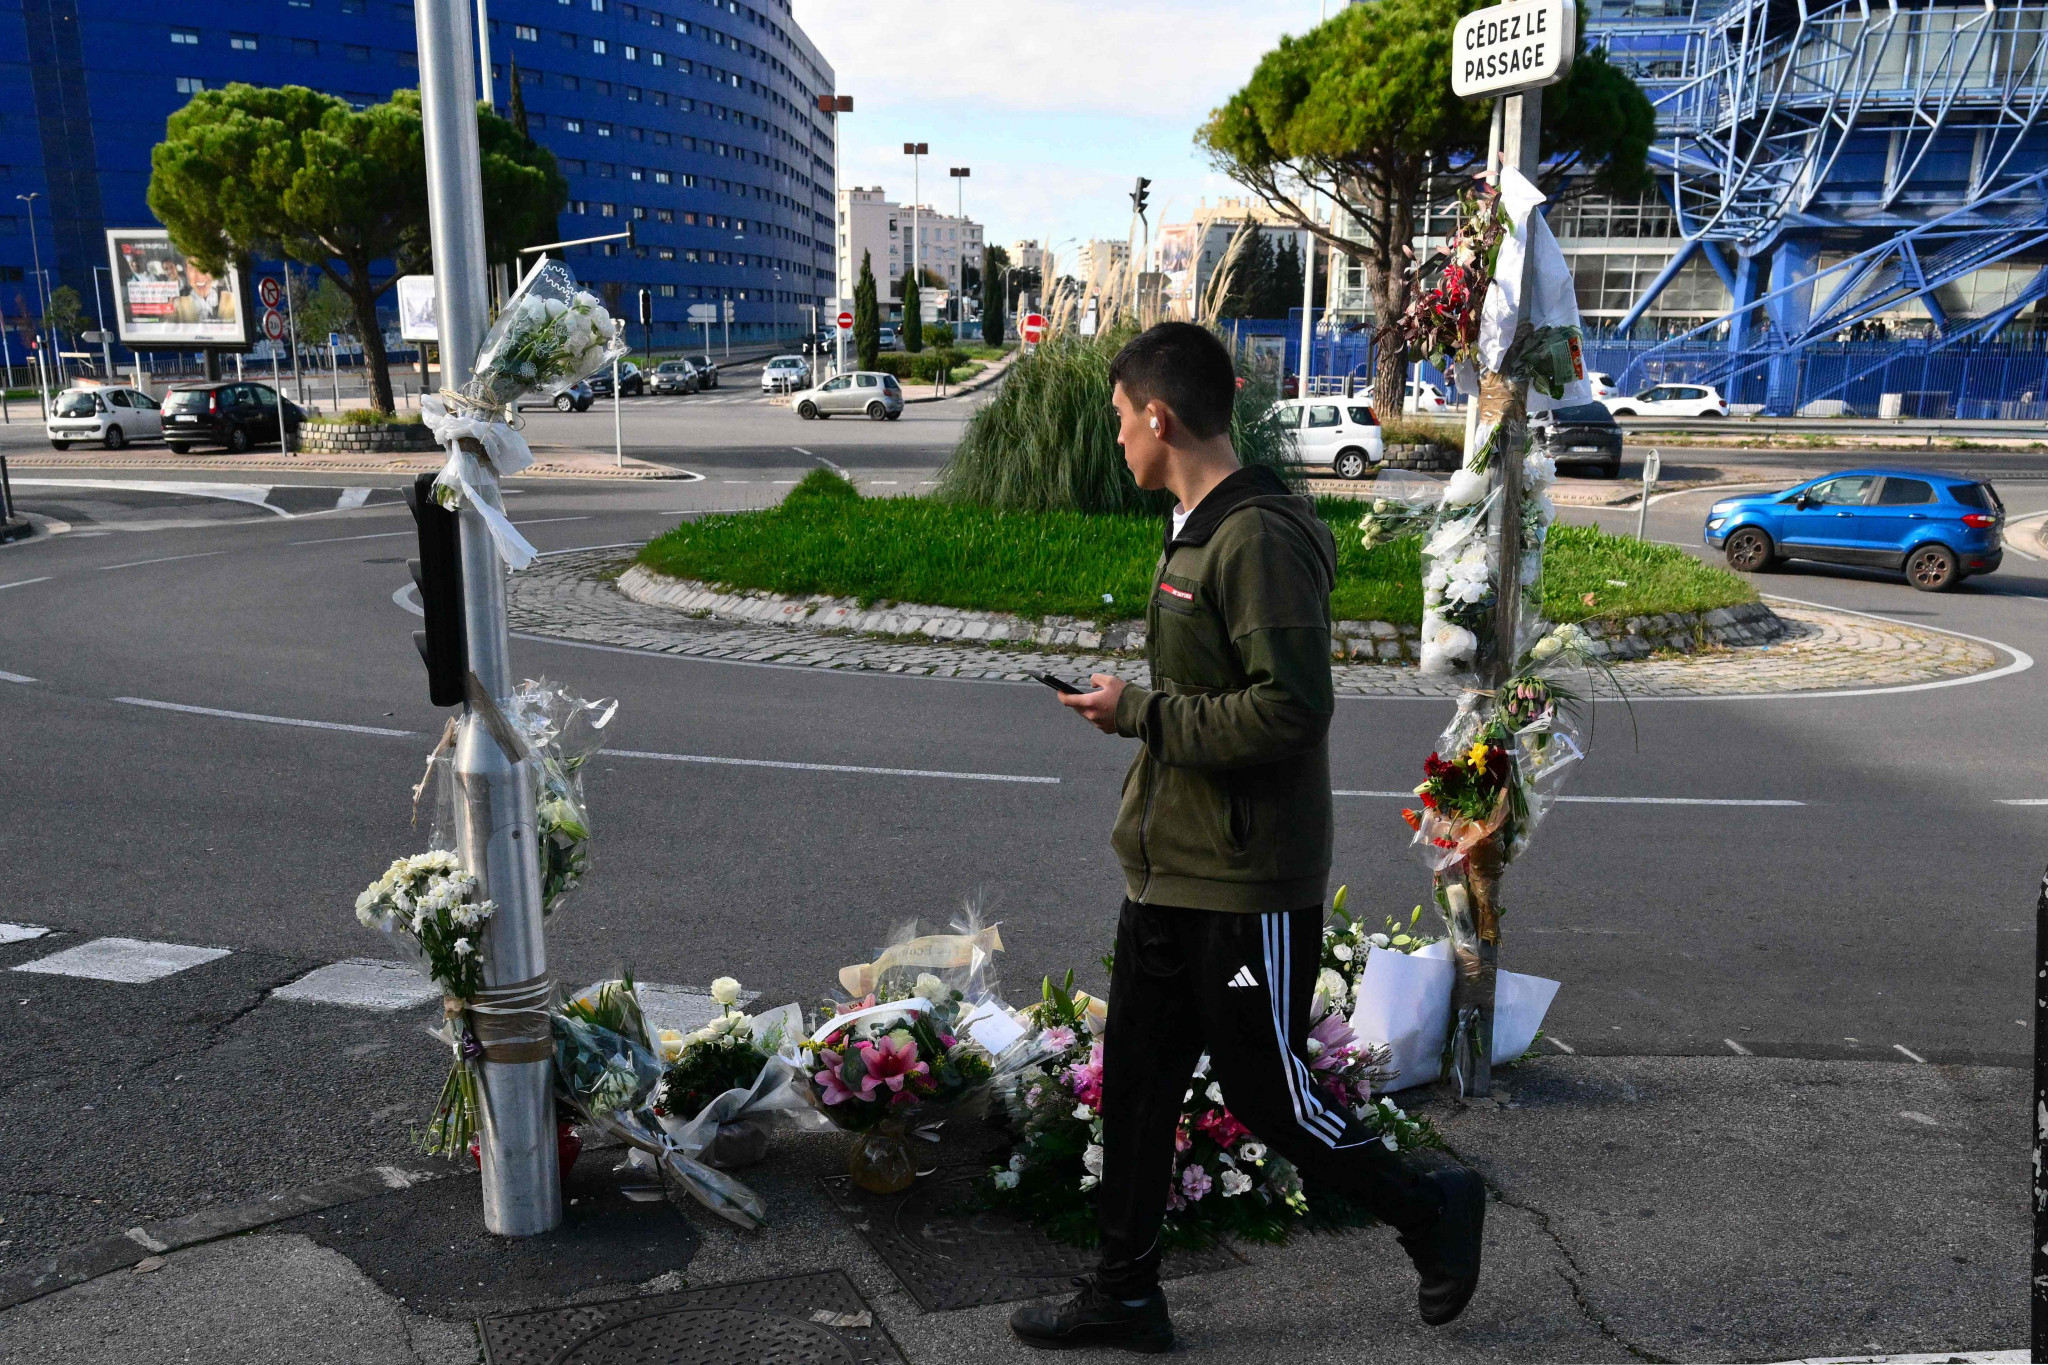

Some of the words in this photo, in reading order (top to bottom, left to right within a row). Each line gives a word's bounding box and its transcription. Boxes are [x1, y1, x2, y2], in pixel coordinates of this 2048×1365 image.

[1466, 16, 1521, 50] CÉDEZ
[1527, 9, 1547, 36] LE
[1465, 43, 1545, 83] PASSAGE
